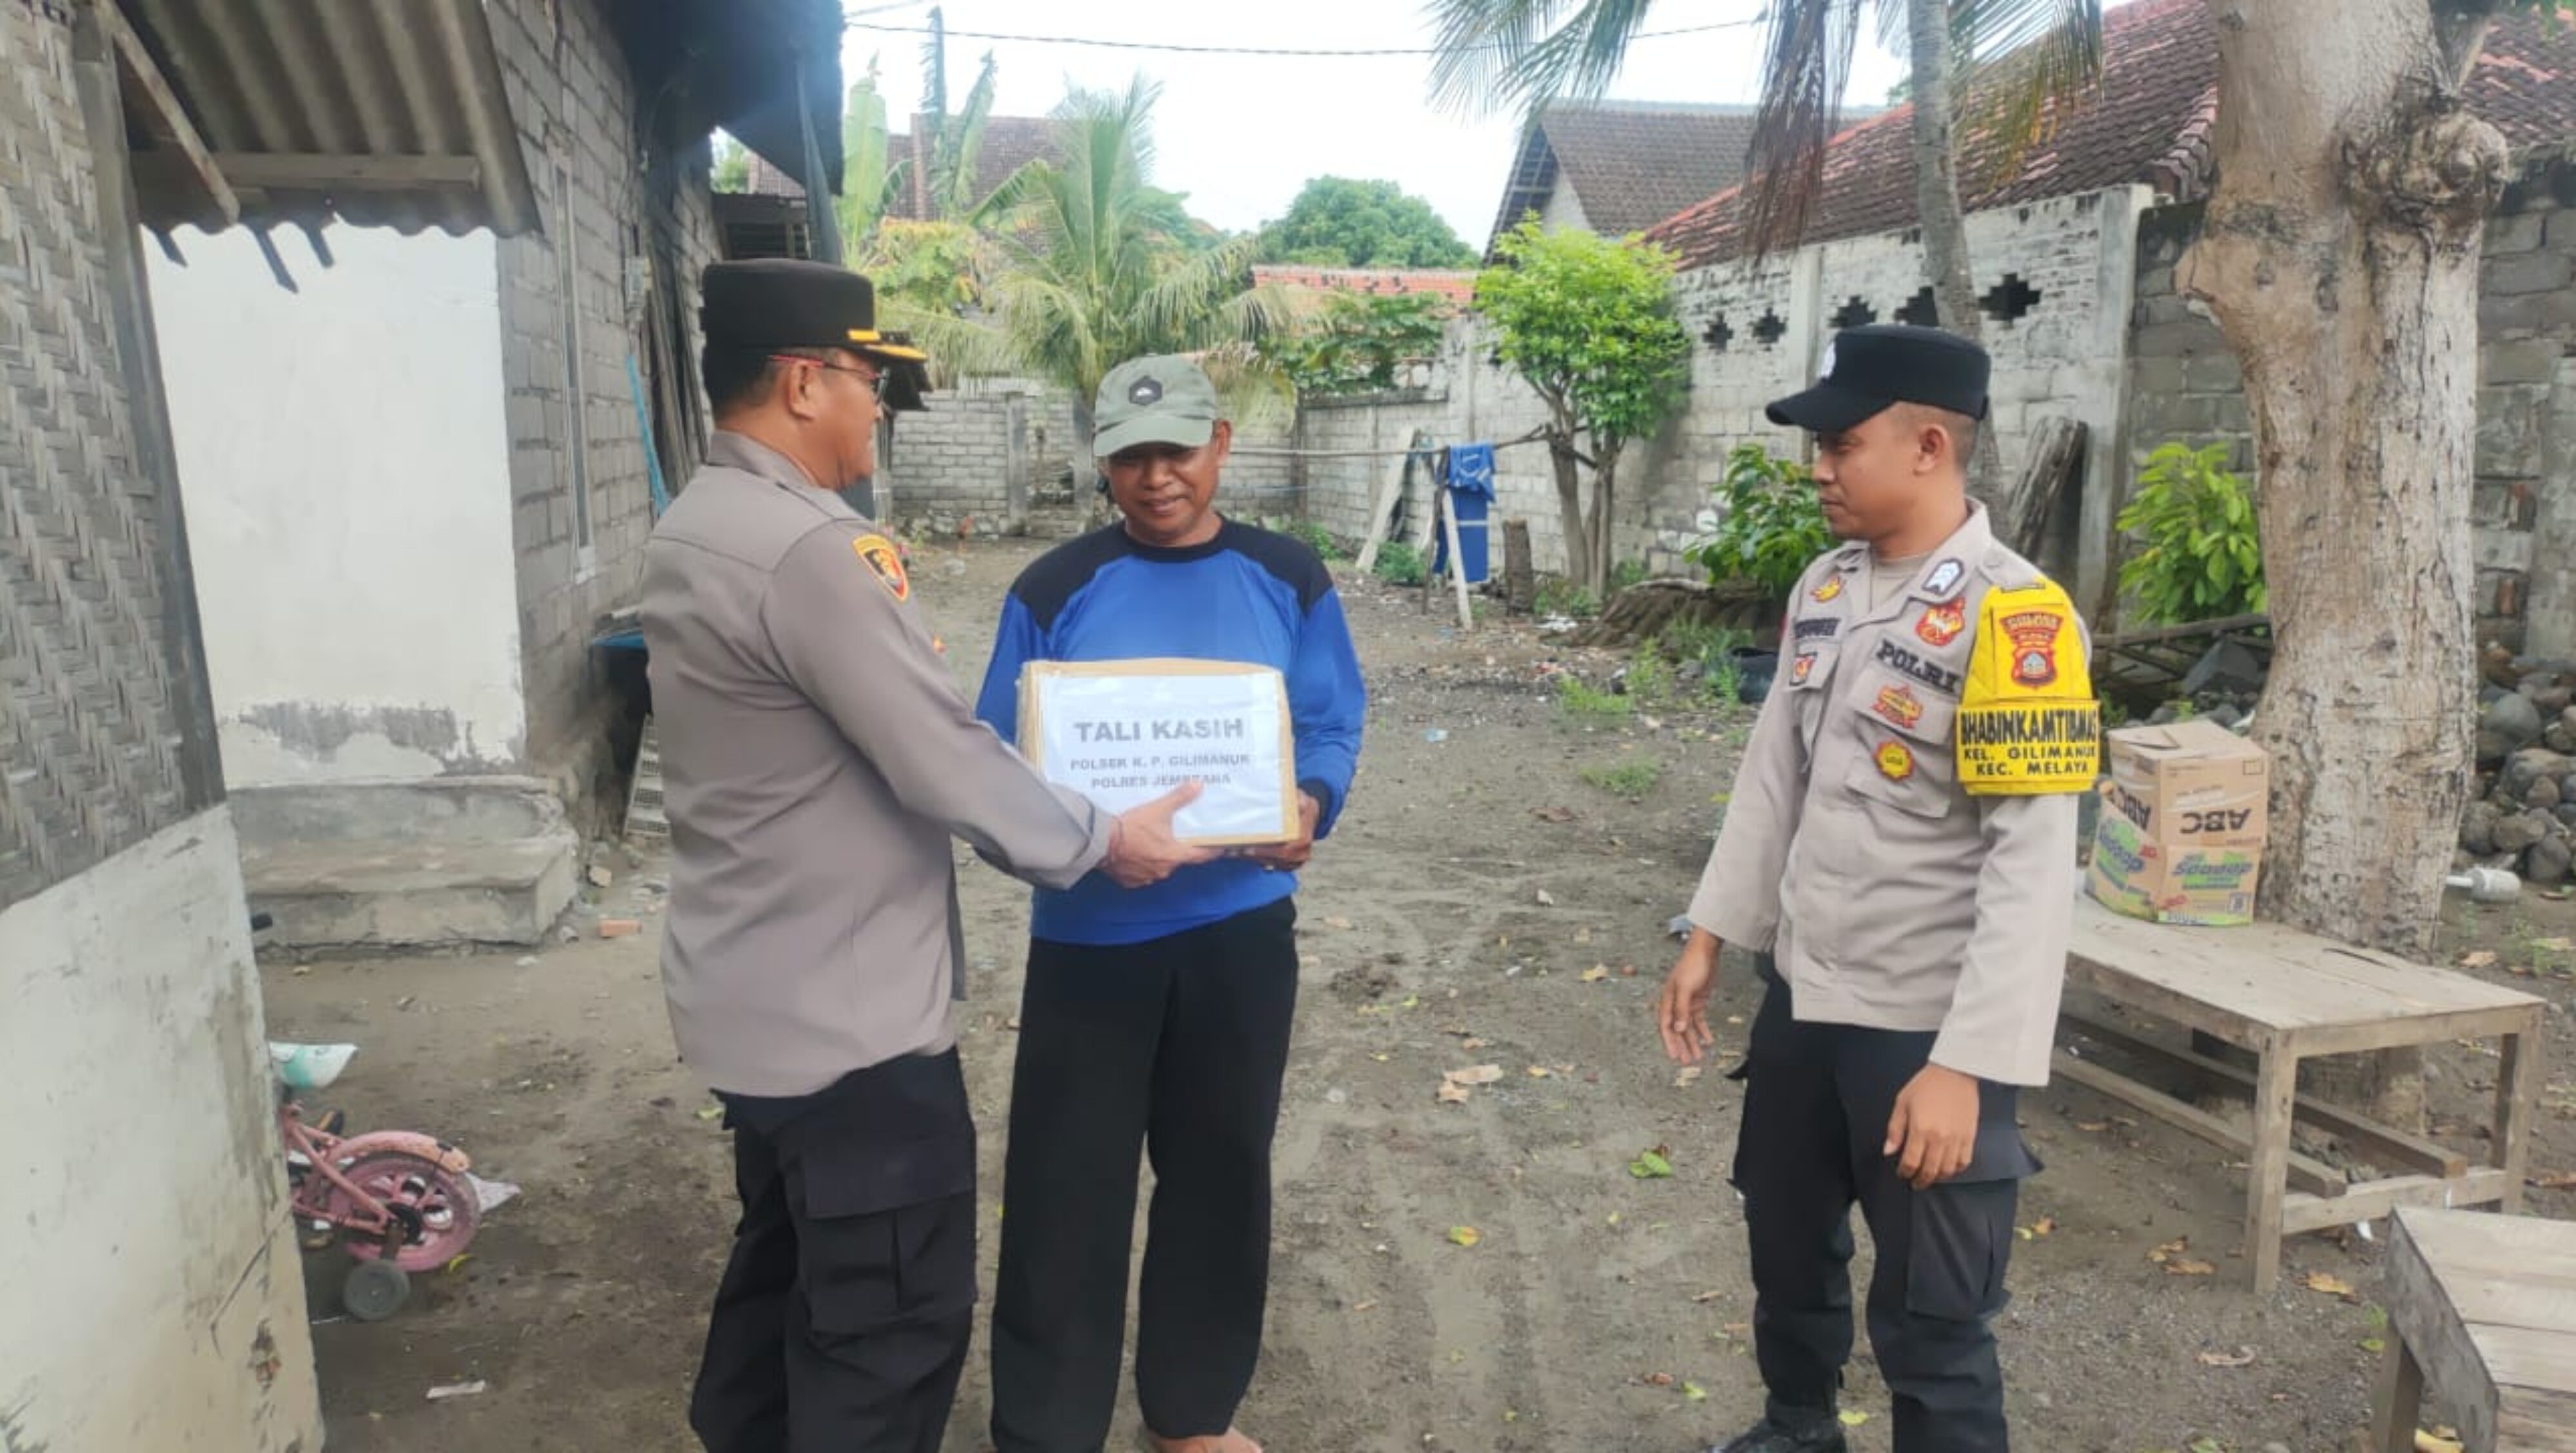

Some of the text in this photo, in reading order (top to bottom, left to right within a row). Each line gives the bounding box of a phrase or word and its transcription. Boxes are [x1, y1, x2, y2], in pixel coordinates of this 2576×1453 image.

[1875, 638, 1961, 693] POLRI
[1074, 718, 1244, 743] TALI KASIH
[1964, 746, 2096, 760] KEL. GILIMANUK
[1070, 757, 1128, 770] POLSEK
[1132, 757, 1146, 768] K.
[1169, 754, 1250, 767] GILIMANUK
[1976, 761, 2088, 775] KEC. MELAYA
[1092, 775, 1147, 788] POLRES
[2179, 808, 2251, 834] ABC
